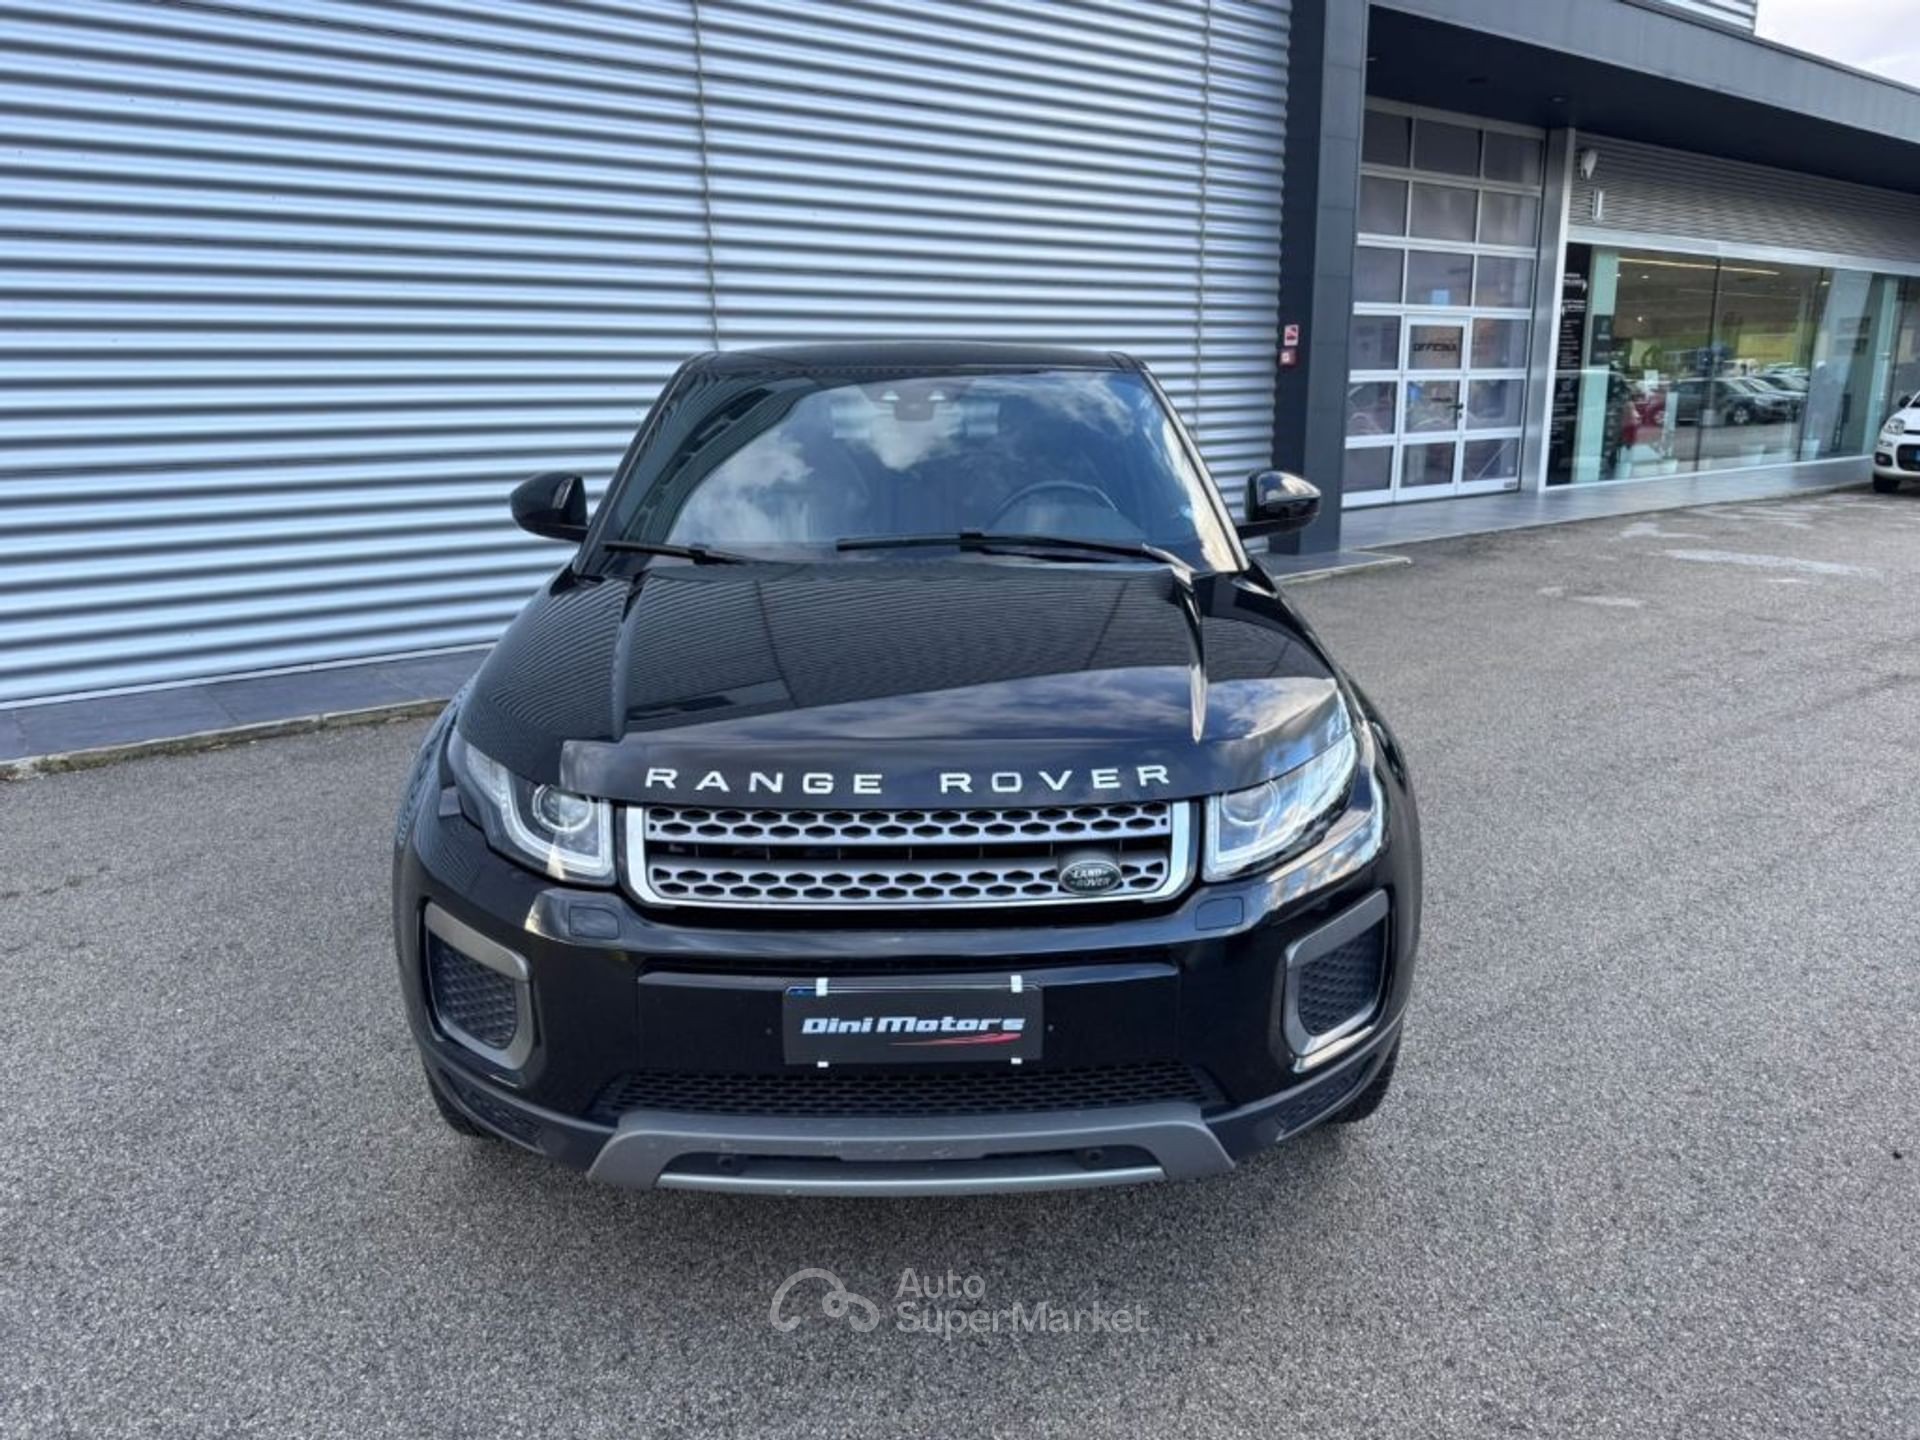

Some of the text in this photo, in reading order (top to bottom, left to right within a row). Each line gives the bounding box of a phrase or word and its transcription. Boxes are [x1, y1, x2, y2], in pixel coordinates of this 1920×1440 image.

[645, 765, 1169, 794] RANGE ROVER
[802, 1016, 1025, 1034] Dini Motors
